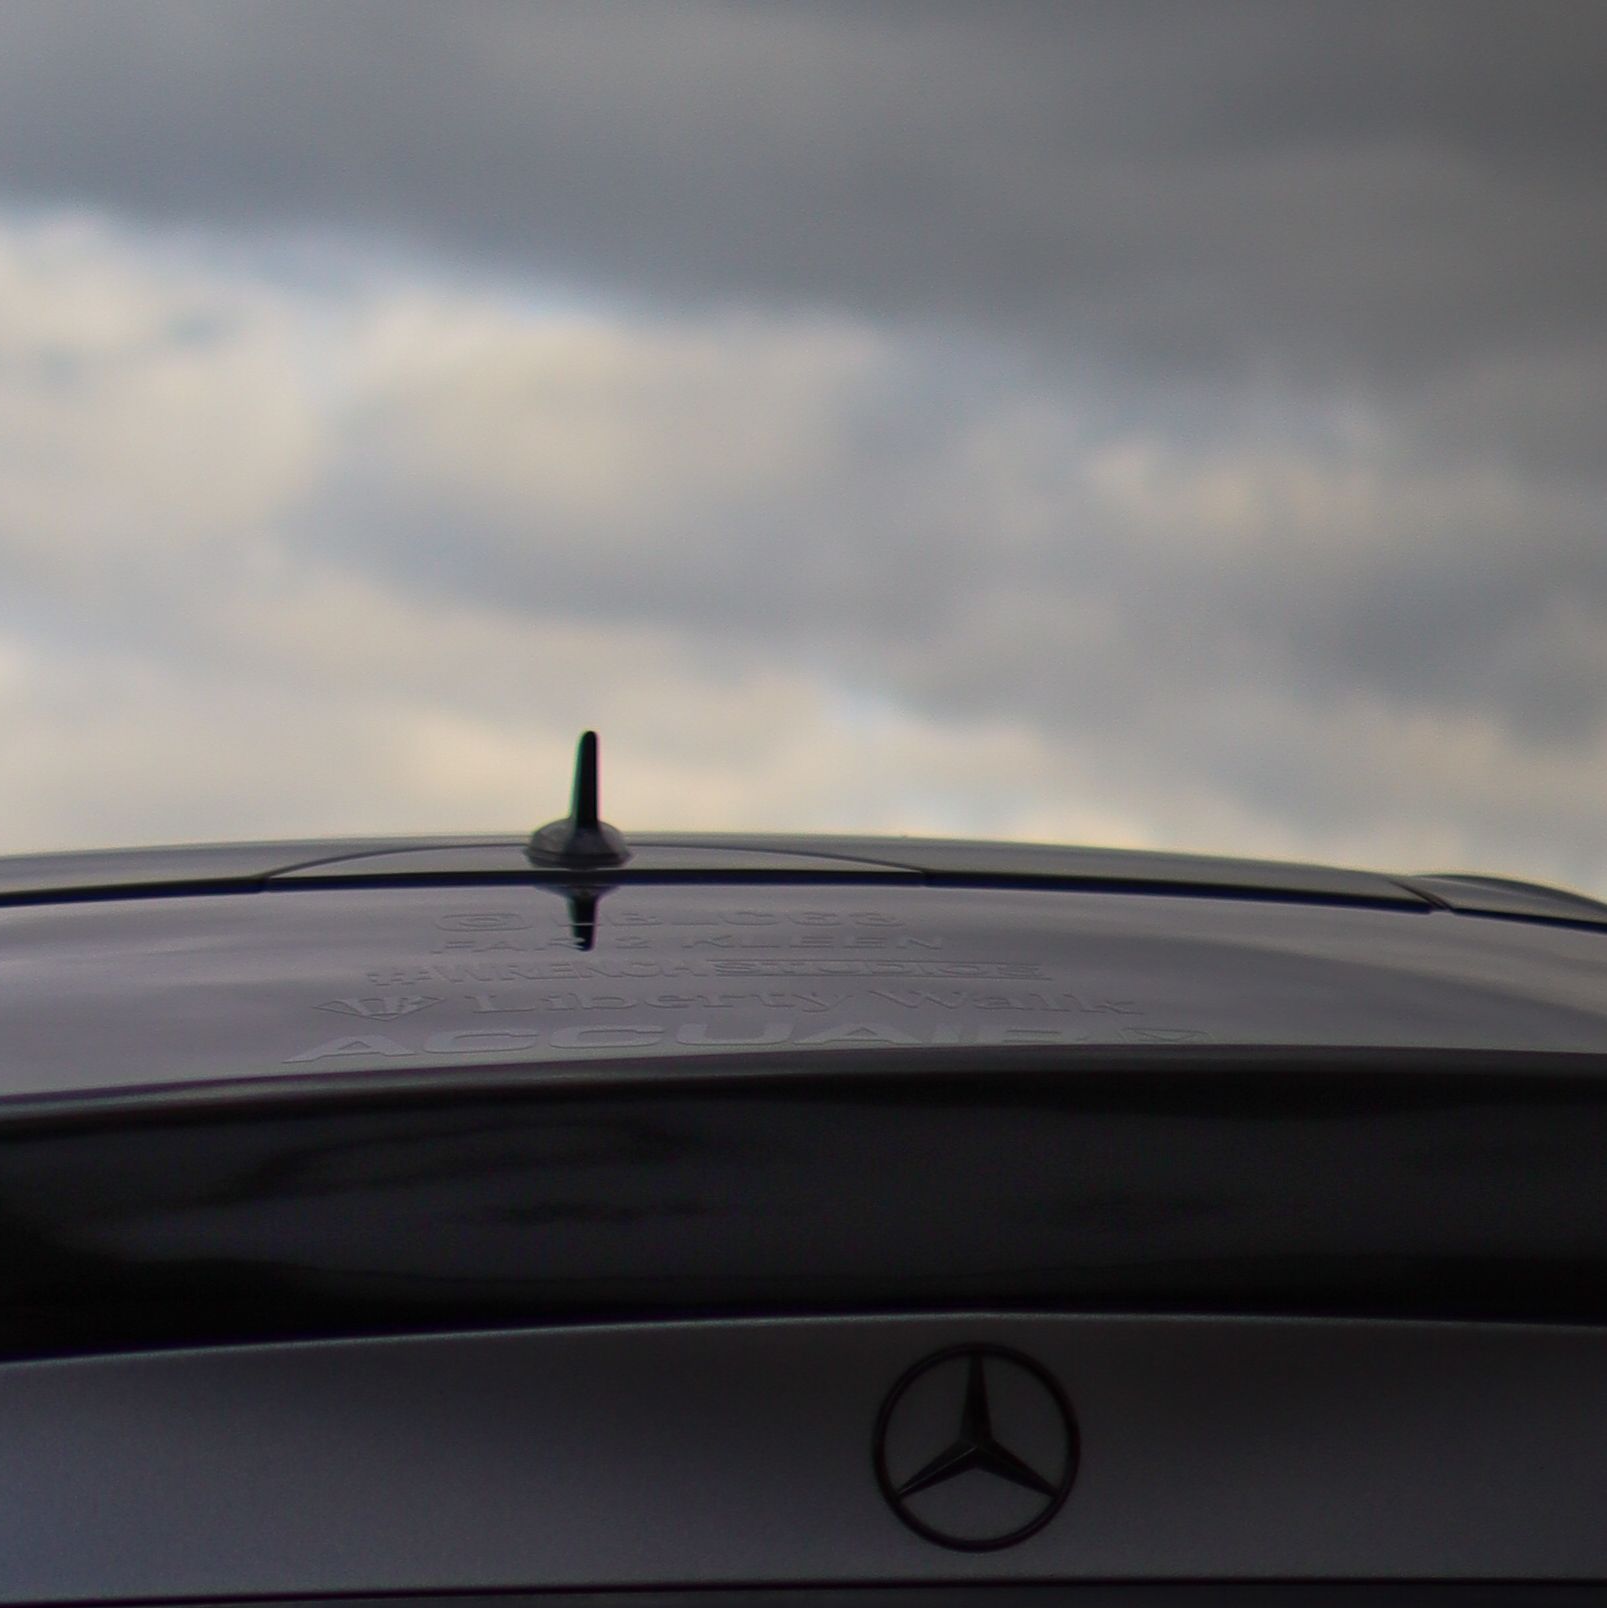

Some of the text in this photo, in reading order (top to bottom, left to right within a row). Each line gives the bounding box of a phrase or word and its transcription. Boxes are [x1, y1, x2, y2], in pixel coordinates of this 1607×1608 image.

[681, 933, 944, 951] KLEEN
[465, 991, 850, 1014] Liberty
[869, 990, 1145, 1015] Walk
[281, 1023, 1092, 1063] ACCUAIR
